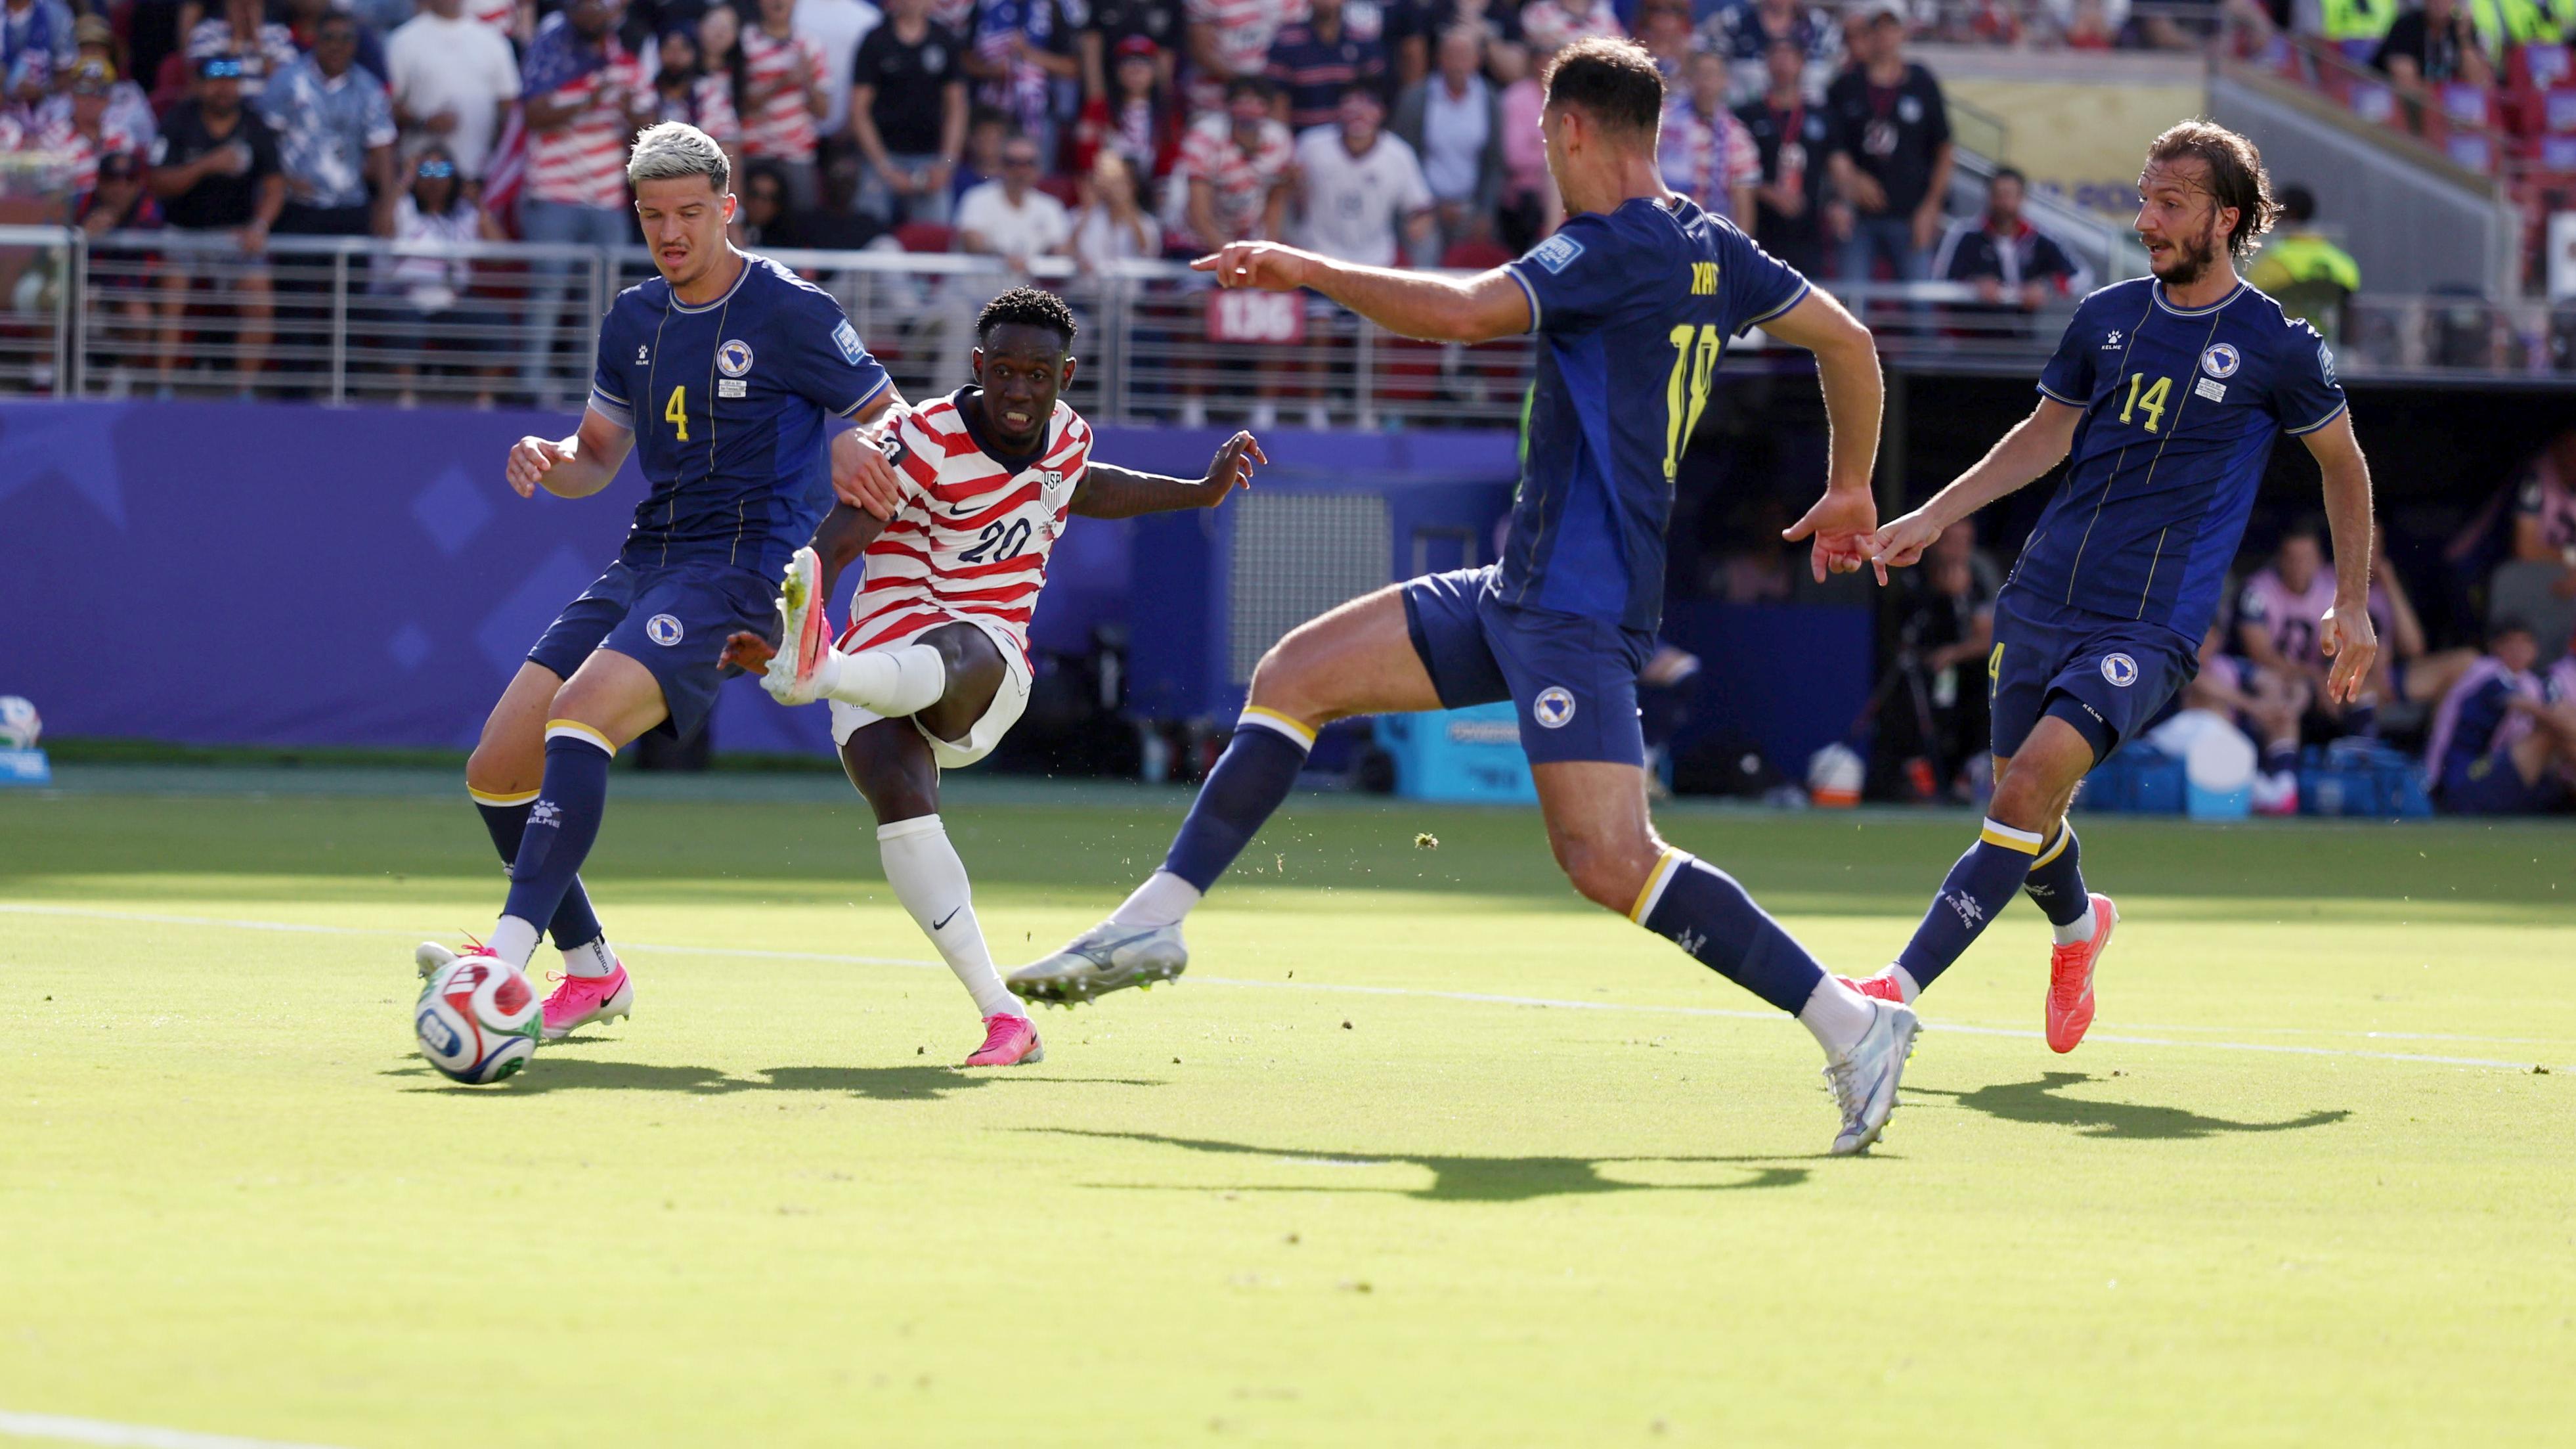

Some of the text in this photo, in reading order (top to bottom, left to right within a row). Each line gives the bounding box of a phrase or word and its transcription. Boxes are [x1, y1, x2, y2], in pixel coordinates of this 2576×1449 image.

[665, 385, 689, 441] 4
[2119, 372, 2173, 434] 14
[1044, 472, 1060, 489] USA
[957, 518, 1031, 564] 20
[2082, 703, 2103, 723] KELME
[1945, 895, 1973, 929] KELME
